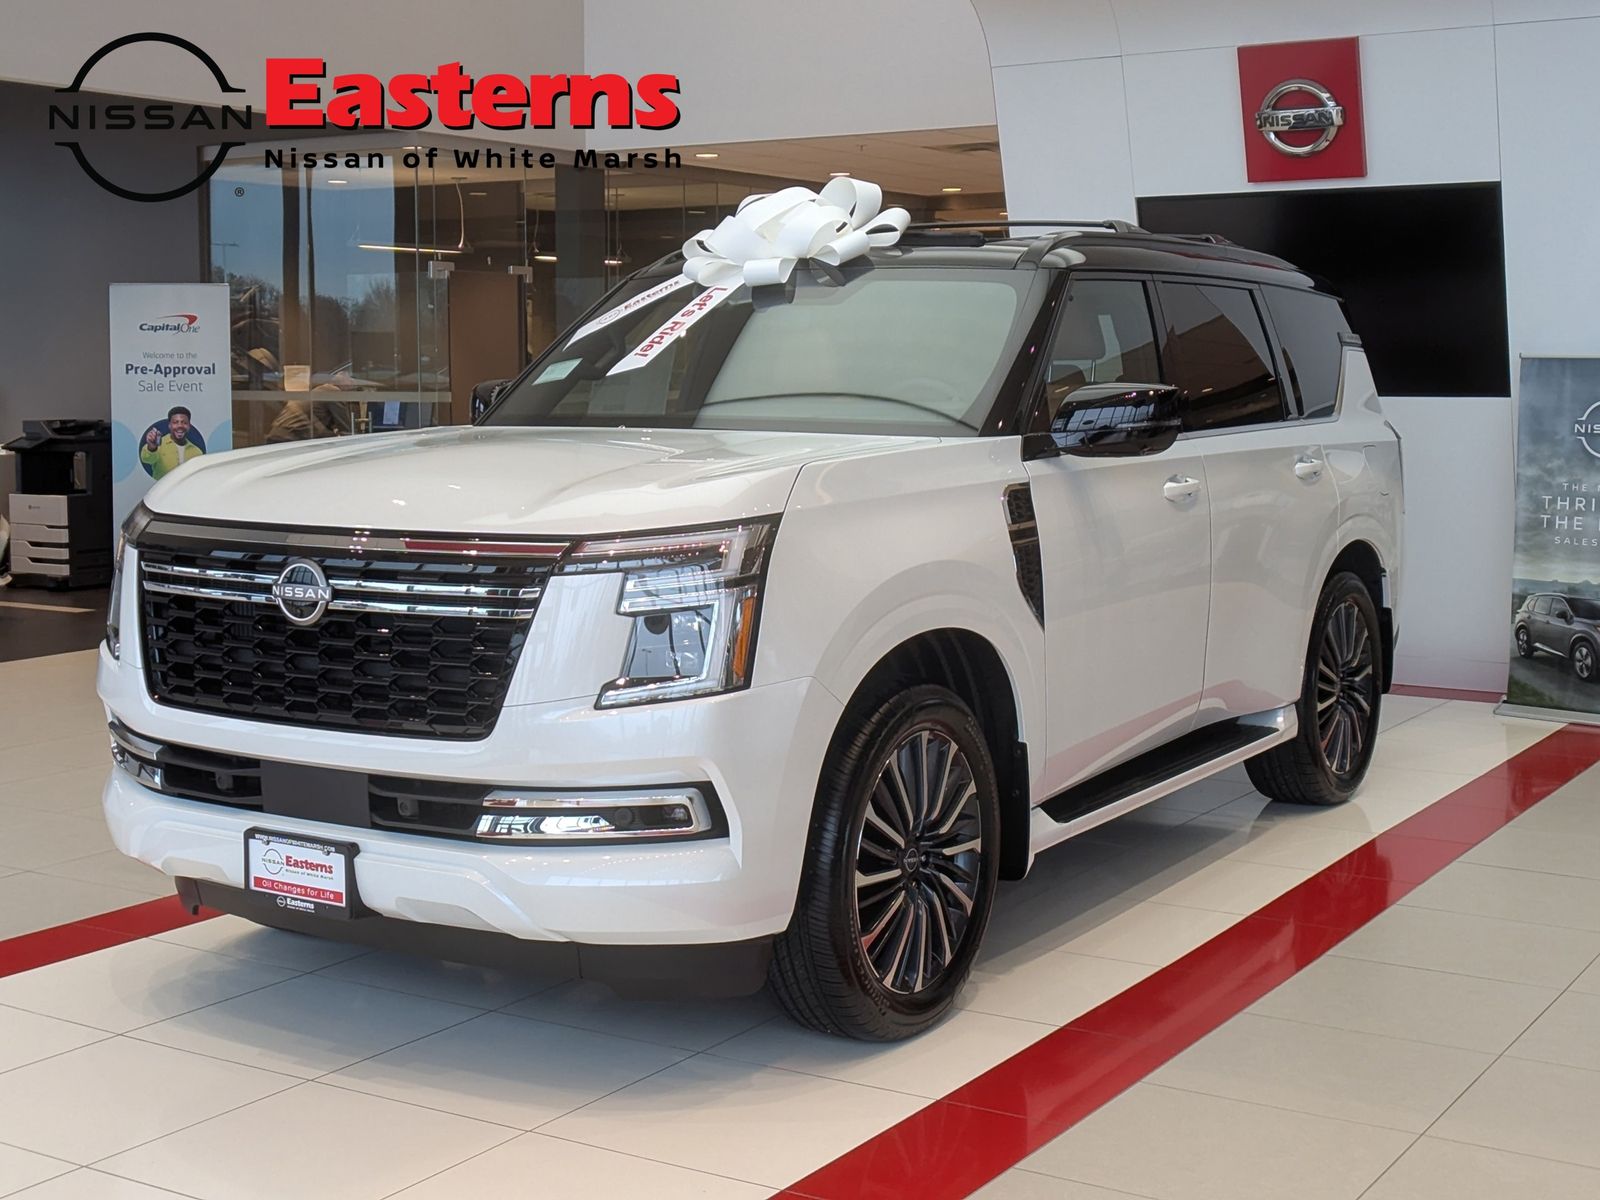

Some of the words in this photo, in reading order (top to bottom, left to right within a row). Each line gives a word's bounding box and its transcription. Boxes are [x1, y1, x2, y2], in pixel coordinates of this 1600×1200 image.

[1263, 109, 1335, 128] NISSAN
[680, 286, 729, 318] Let's
[142, 351, 175, 359] Welcome
[185, 351, 198, 359] the
[125, 363, 216, 378] Pre-Approval
[138, 380, 164, 392] Sale
[168, 380, 203, 392] Event
[1562, 482, 1587, 492] THE
[1541, 495, 1596, 512] THRI
[1540, 514, 1584, 530] THE
[1554, 536, 1598, 547] SALES
[272, 585, 330, 600] NISSAN
[262, 857, 285, 866] NISSAN
[285, 854, 334, 875] Easterns
[262, 880, 272, 888] Oil
[273, 881, 305, 894] Changes
[307, 887, 318, 896] for
[320, 891, 335, 900] Life
[286, 897, 315, 910] Easterns
